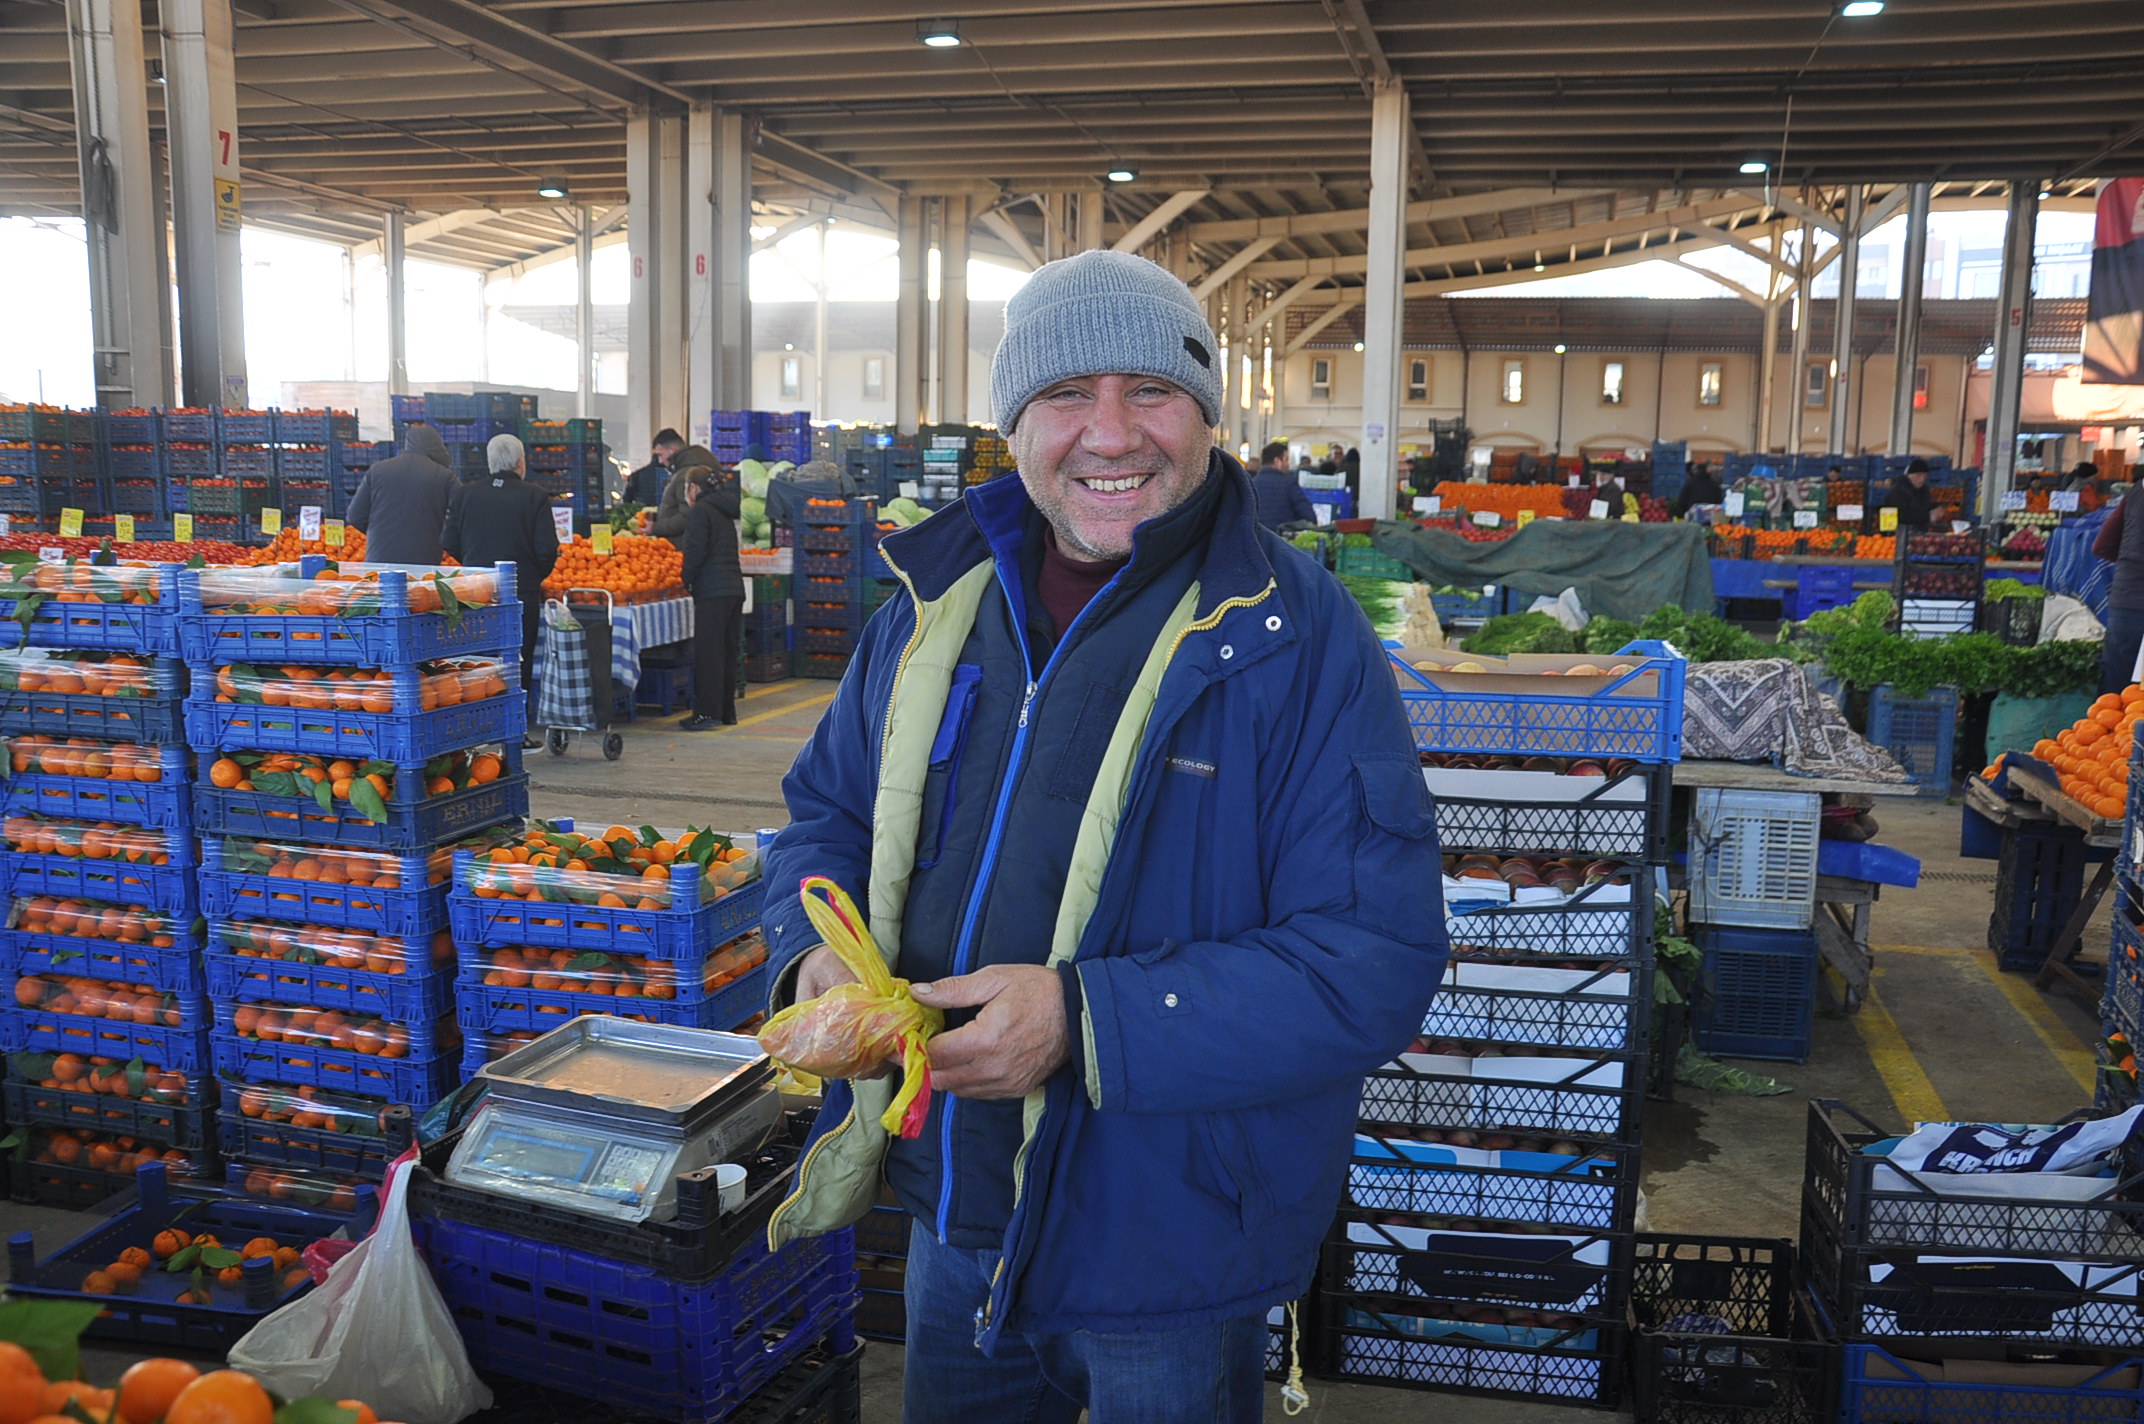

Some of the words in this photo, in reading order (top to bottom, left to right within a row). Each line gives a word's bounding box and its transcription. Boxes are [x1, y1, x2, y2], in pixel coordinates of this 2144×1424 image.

[218, 129, 231, 166] 7
[633, 257, 643, 278] 6
[695, 254, 705, 275] 6
[2011, 308, 2021, 326] 5
[1172, 758, 1216, 772] ECOLOGY
[1938, 1146, 2041, 1173] KRNCH
